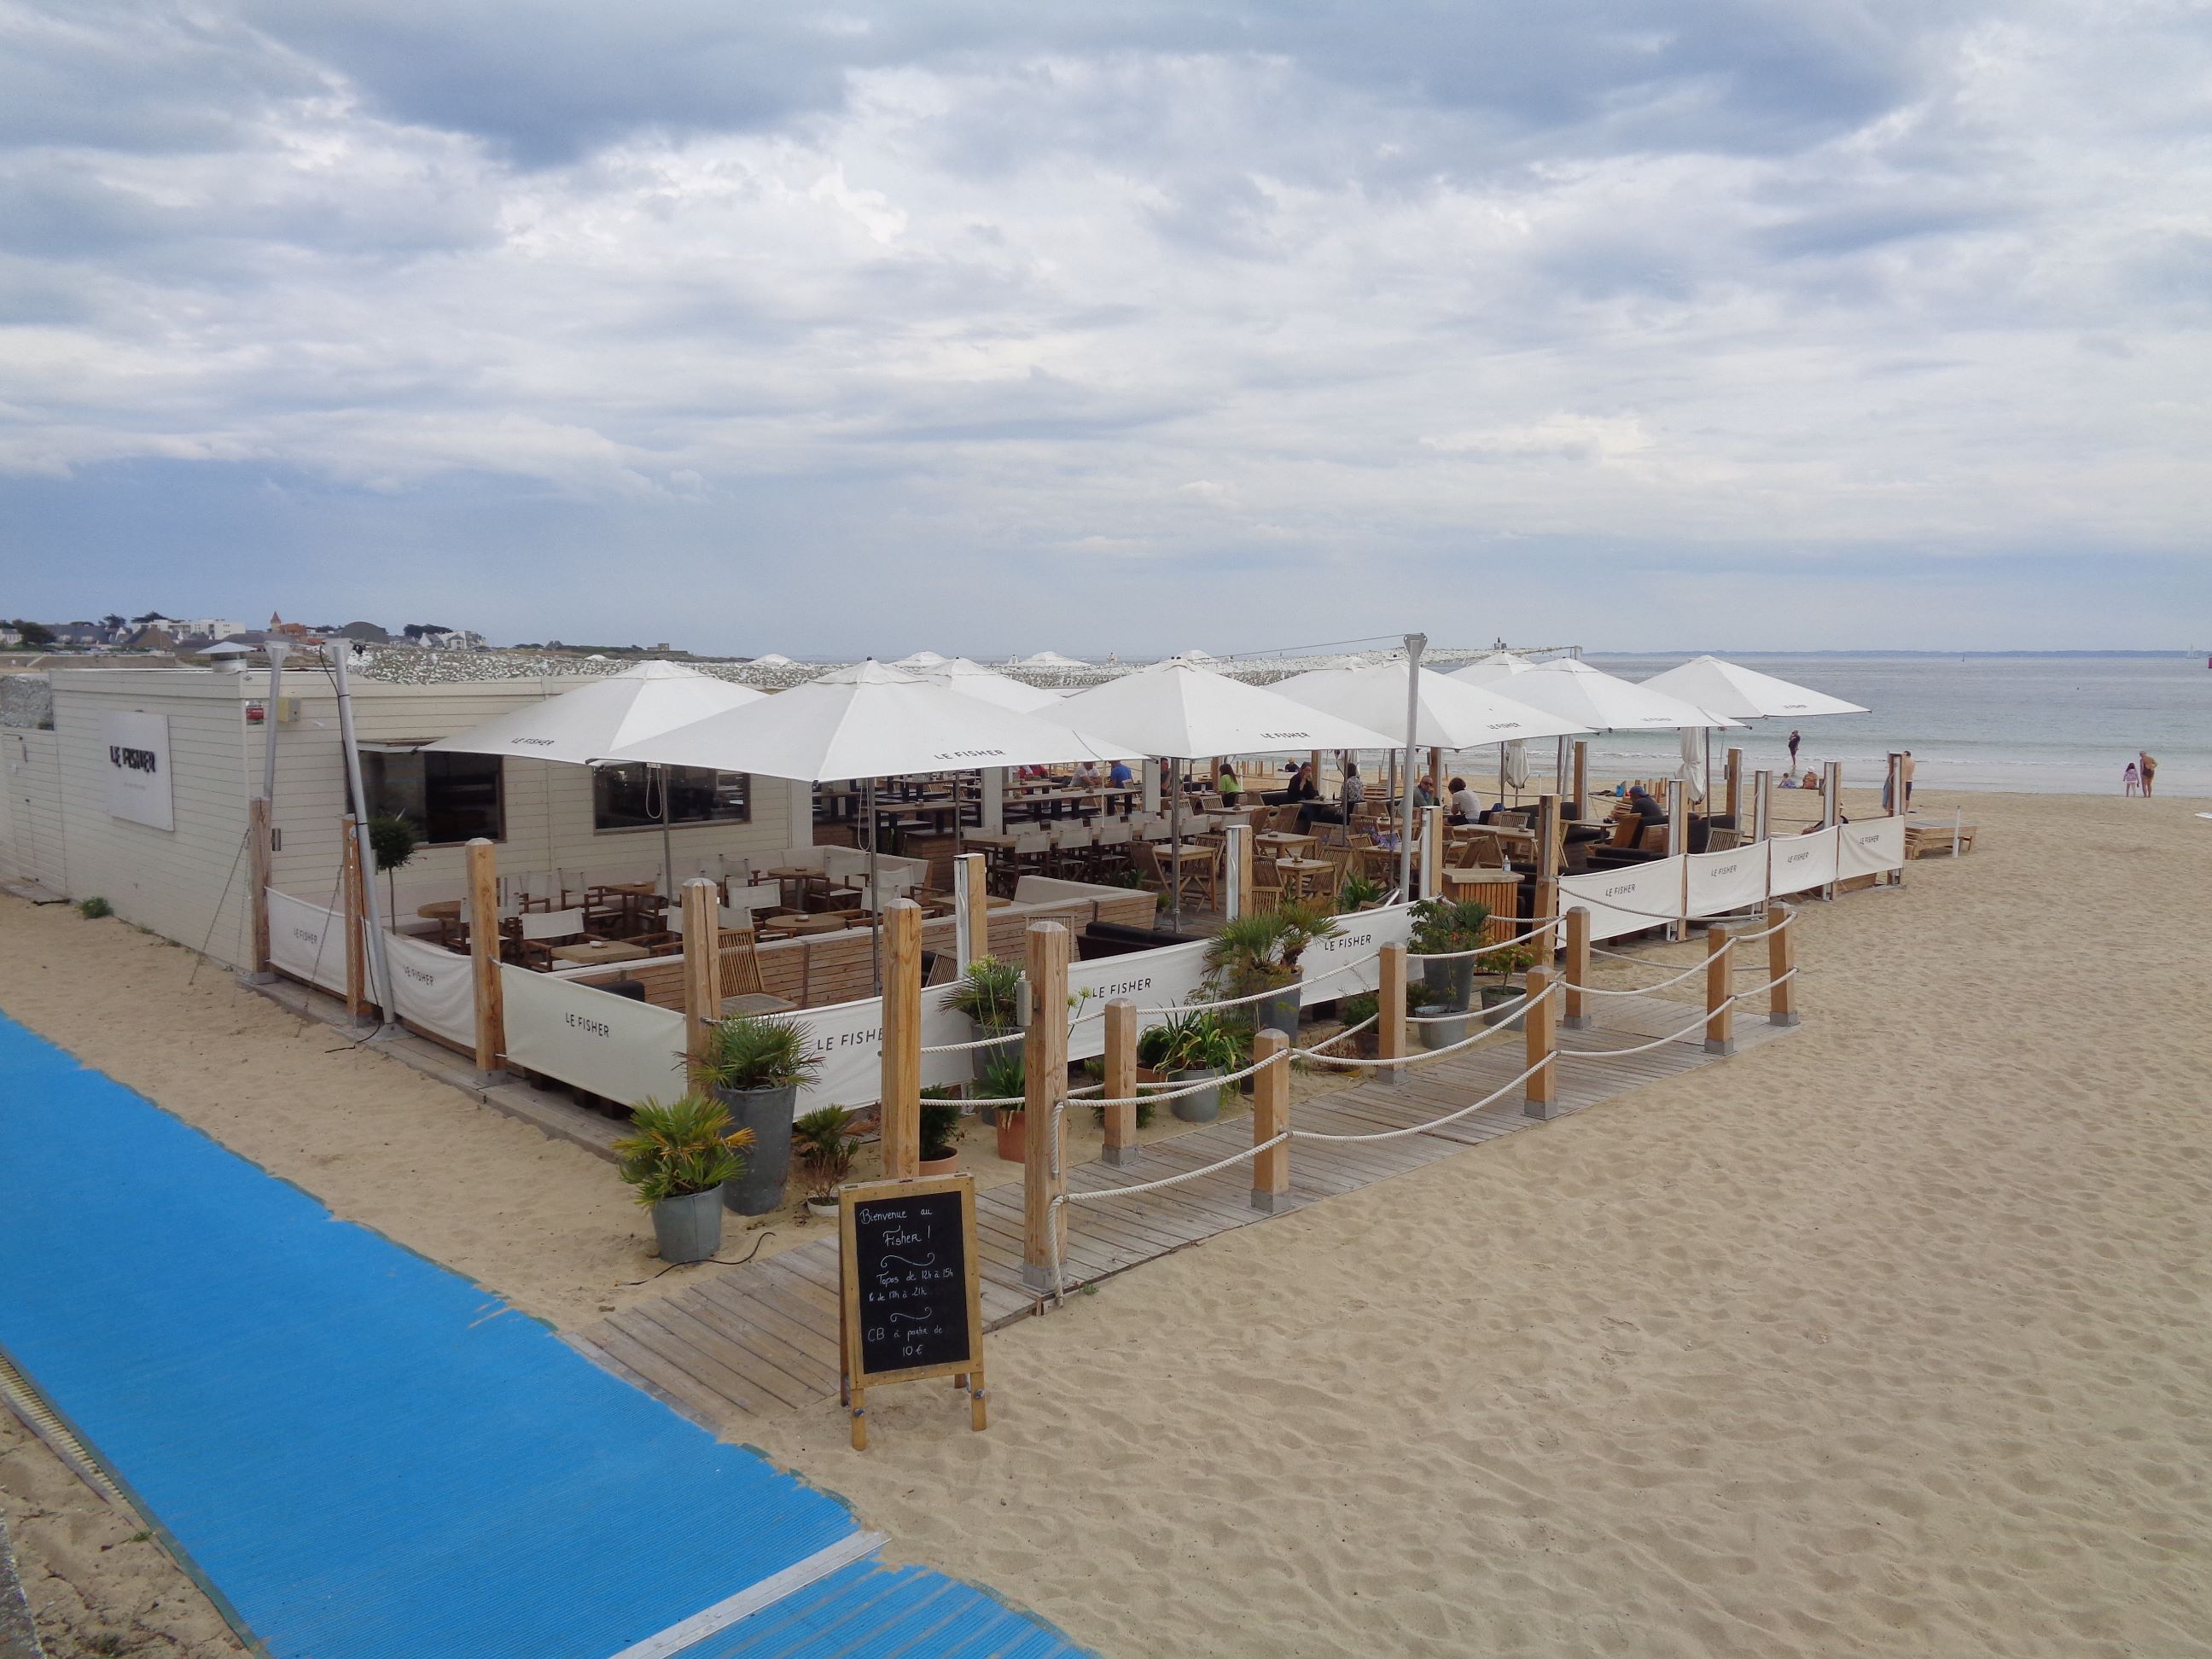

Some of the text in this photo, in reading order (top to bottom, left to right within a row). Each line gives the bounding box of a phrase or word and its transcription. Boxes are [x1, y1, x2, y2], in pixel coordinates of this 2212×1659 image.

[109, 745, 156, 773] LE FISHER
[953, 749, 1006, 758] FISHER
[1711, 864, 1737, 877] LE FISHER
[1605, 883, 1636, 897] LE FISHER
[300, 929, 317, 945] FISHER
[1324, 934, 1371, 952] LE FISHER
[404, 963, 434, 987] LE FISHER
[1092, 978, 1151, 998] LE FISHER
[566, 1012, 609, 1038] LE FISHER
[817, 1027, 882, 1051] LE FISHE
[860, 1208, 907, 1224] Bienvenue
[876, 1270, 899, 1288] Tapas
[906, 1271, 917, 1281] de
[943, 1267, 953, 1278] 15h
[912, 1287, 927, 1296] 21h
[867, 1327, 884, 1342] CB
[934, 1325, 942, 1334] de
